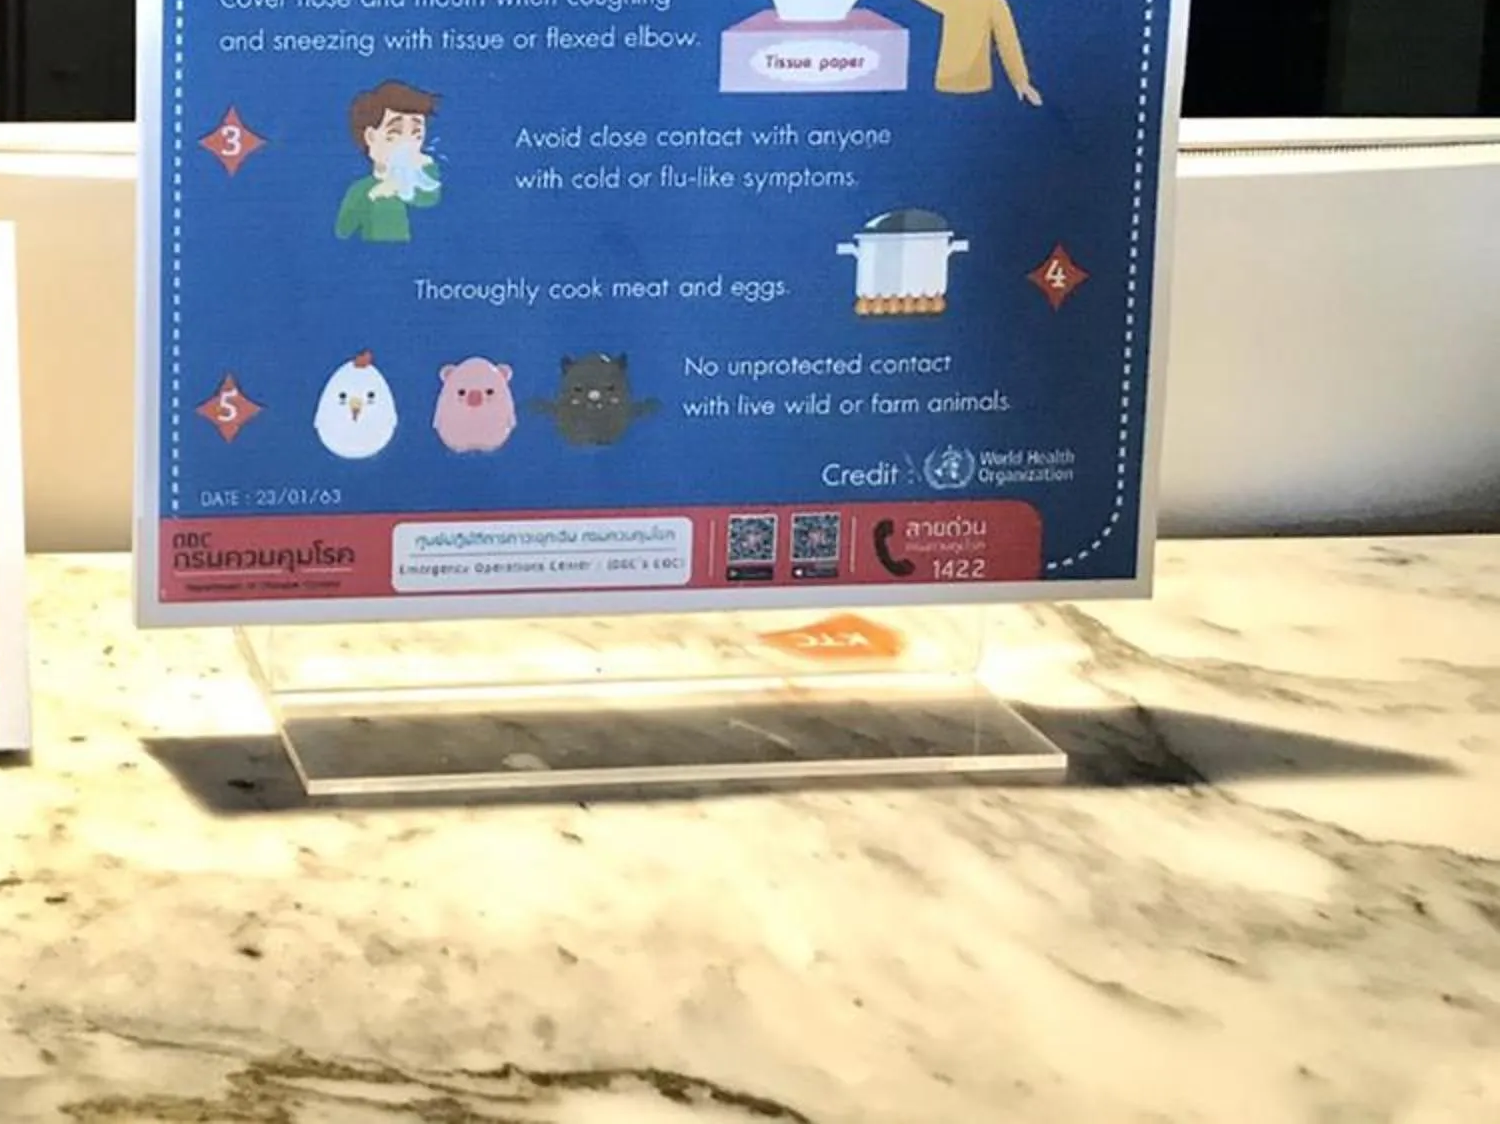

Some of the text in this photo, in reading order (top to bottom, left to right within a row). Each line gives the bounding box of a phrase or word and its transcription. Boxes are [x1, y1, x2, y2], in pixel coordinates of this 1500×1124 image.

[219, 24, 702, 56] and sneezing with tissue or flexed elbow.
[765, 54, 866, 72] Tissue paper
[220, 125, 242, 156] 3
[515, 124, 892, 152] Avoid close contact with anyone
[515, 165, 861, 193] with cold or flu-like symptoms.
[1044, 259, 1067, 289] 4
[413, 275, 791, 306] Thoroughly cook meat and eggs.
[684, 354, 952, 380] No unprotected contact
[217, 387, 239, 422] 5
[682, 395, 730, 417] with
[737, 394, 775, 416] live
[784, 393, 832, 415] wild
[839, 397, 862, 415] or
[871, 392, 920, 414] farm
[978, 447, 1075, 466] World Health
[821, 462, 899, 488] Credit
[977, 466, 1074, 486] Organization
[201, 491, 240, 507] DATE
[256, 489, 342, 506] 23/01/63
[905, 515, 987, 538] สายด่วน
[173, 540, 356, 573] กรมควบคุมโรค
[932, 559, 986, 579] 1422
